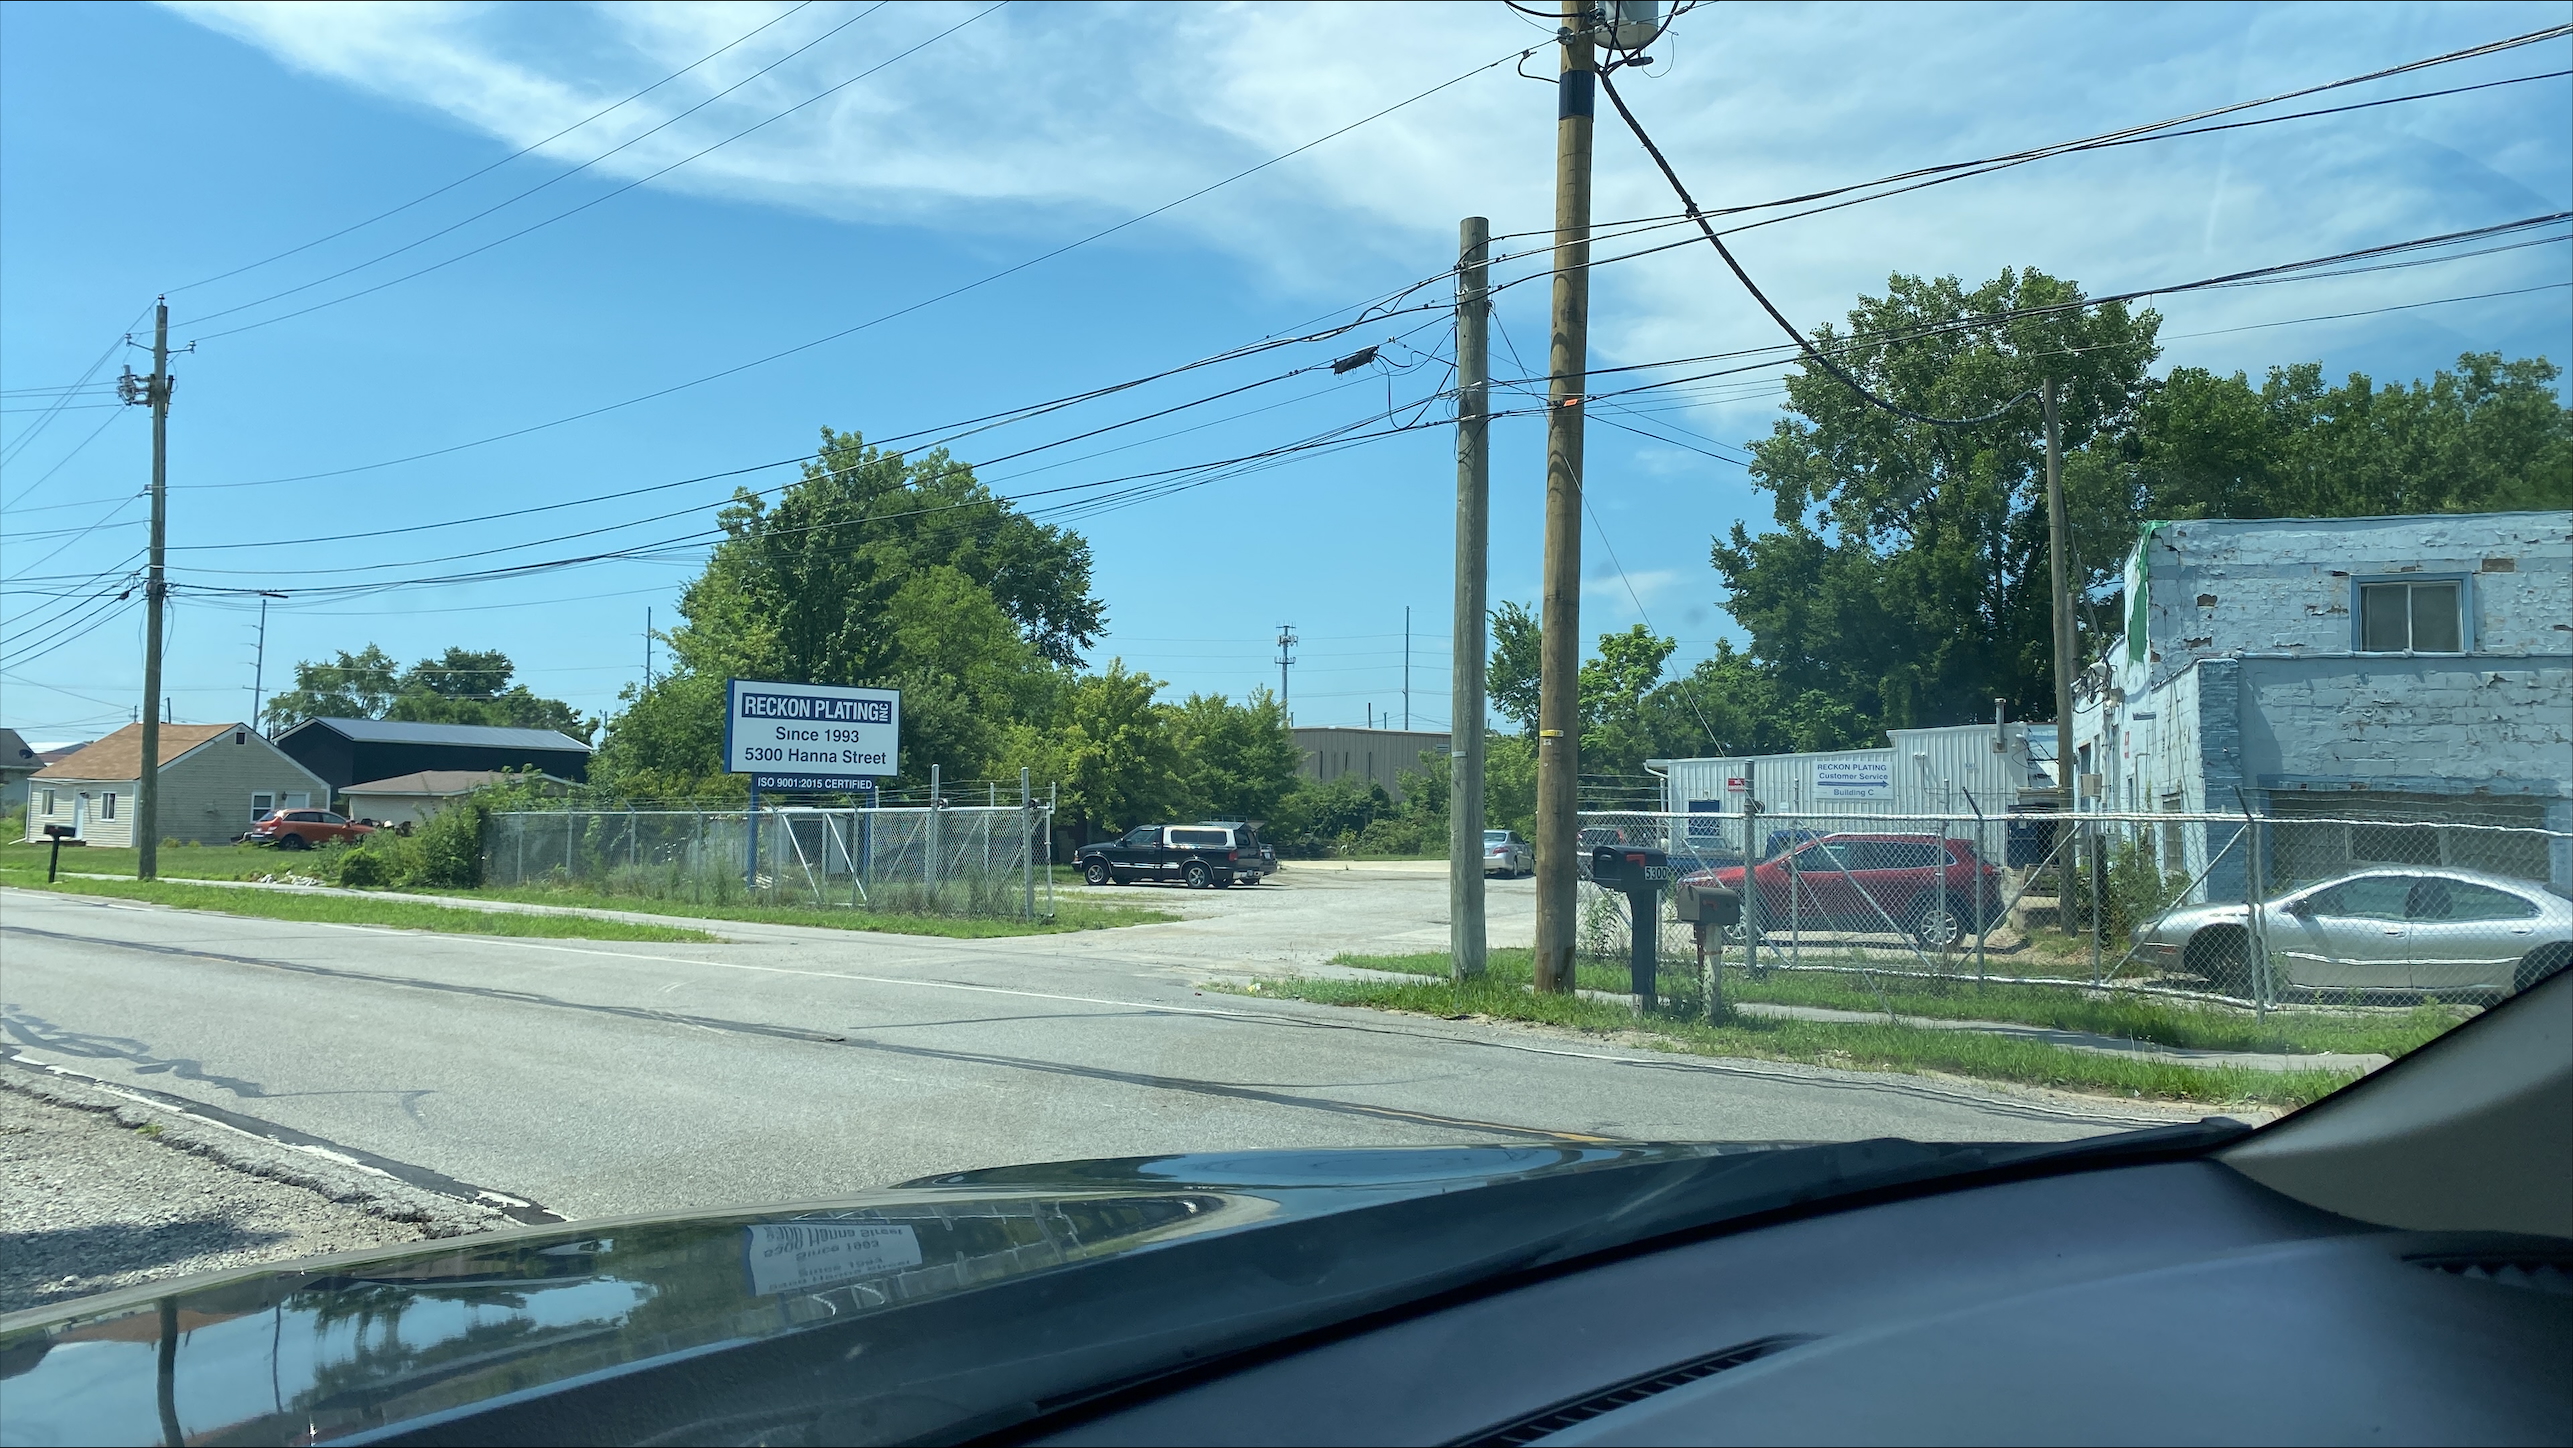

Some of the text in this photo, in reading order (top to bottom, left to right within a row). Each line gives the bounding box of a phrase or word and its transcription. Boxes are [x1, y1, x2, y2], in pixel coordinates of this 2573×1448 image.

[744, 695, 879, 721] RECKON PLATING
[879, 703, 889, 722] INC
[775, 726, 859, 743] Since 1993
[744, 747, 887, 765] 5300 Hanna Street
[1817, 763, 1887, 771] RECKON PLATING
[757, 776, 873, 790] ISO 9001:2015 CERTIFIED
[1818, 772, 1889, 780] Customer Service
[1833, 788, 1875, 797] Building C
[1646, 867, 1667, 879] 5300
